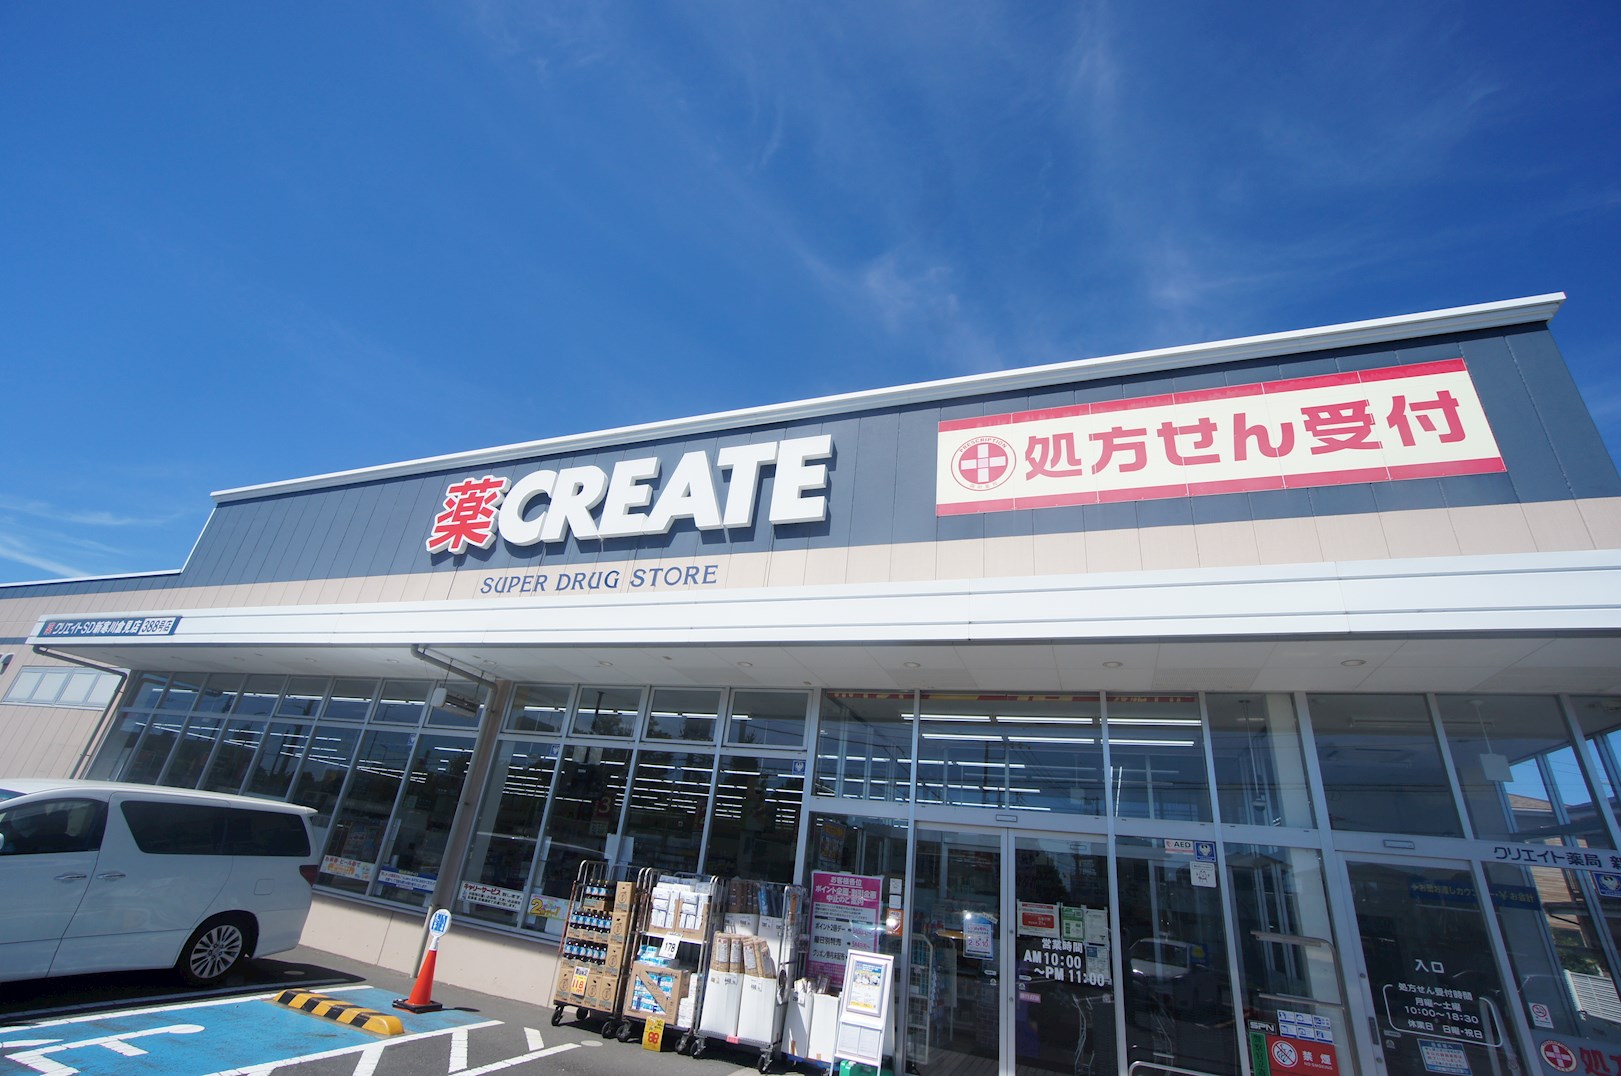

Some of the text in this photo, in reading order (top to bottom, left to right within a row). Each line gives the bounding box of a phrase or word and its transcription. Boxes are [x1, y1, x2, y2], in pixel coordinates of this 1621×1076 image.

[1025, 389, 1467, 481] 処方せん受付
[426, 434, 833, 554] 薬 CREATE
[480, 564, 719, 594] SUPER DRUG STORE
[1494, 846, 1603, 868] クリエイト薬局
[664, 942, 676, 953] 178
[1042, 938, 1083, 954] 営業時間
[1415, 958, 1445, 974] 入口
[1398, 982, 1473, 1001] 処方せん受付時間
[1407, 1019, 1434, 1031] 休業日
